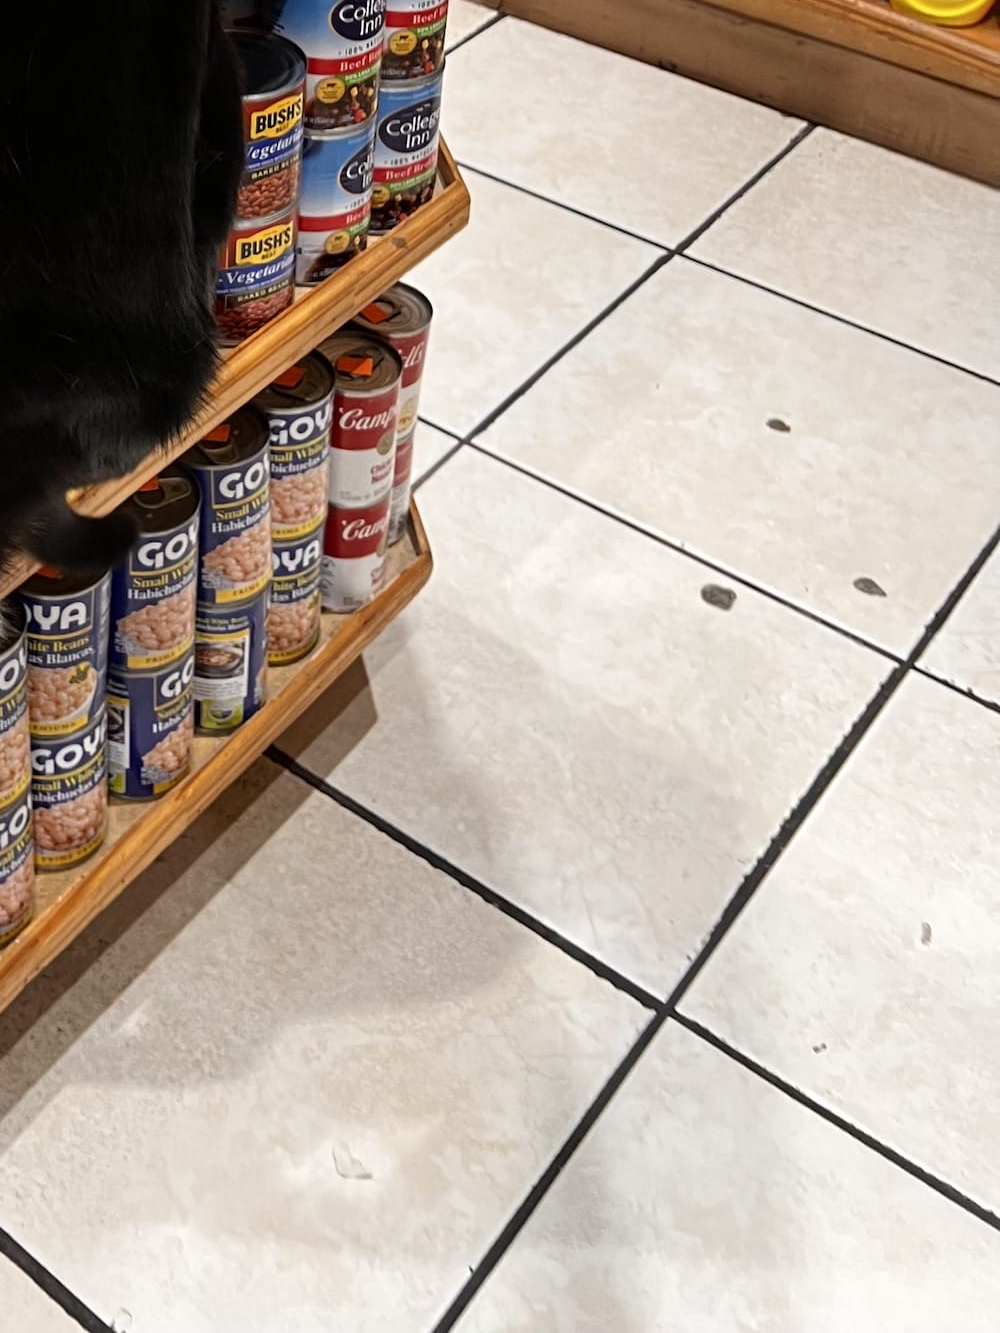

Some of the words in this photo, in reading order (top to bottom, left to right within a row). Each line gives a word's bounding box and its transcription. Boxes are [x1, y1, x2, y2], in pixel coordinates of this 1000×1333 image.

[359, 18, 382, 36] Inn
[255, 98, 302, 135] BUSH'S
[405, 131, 431, 149] Inn
[240, 226, 292, 261] BUSH'S
[133, 575, 168, 589] Small
